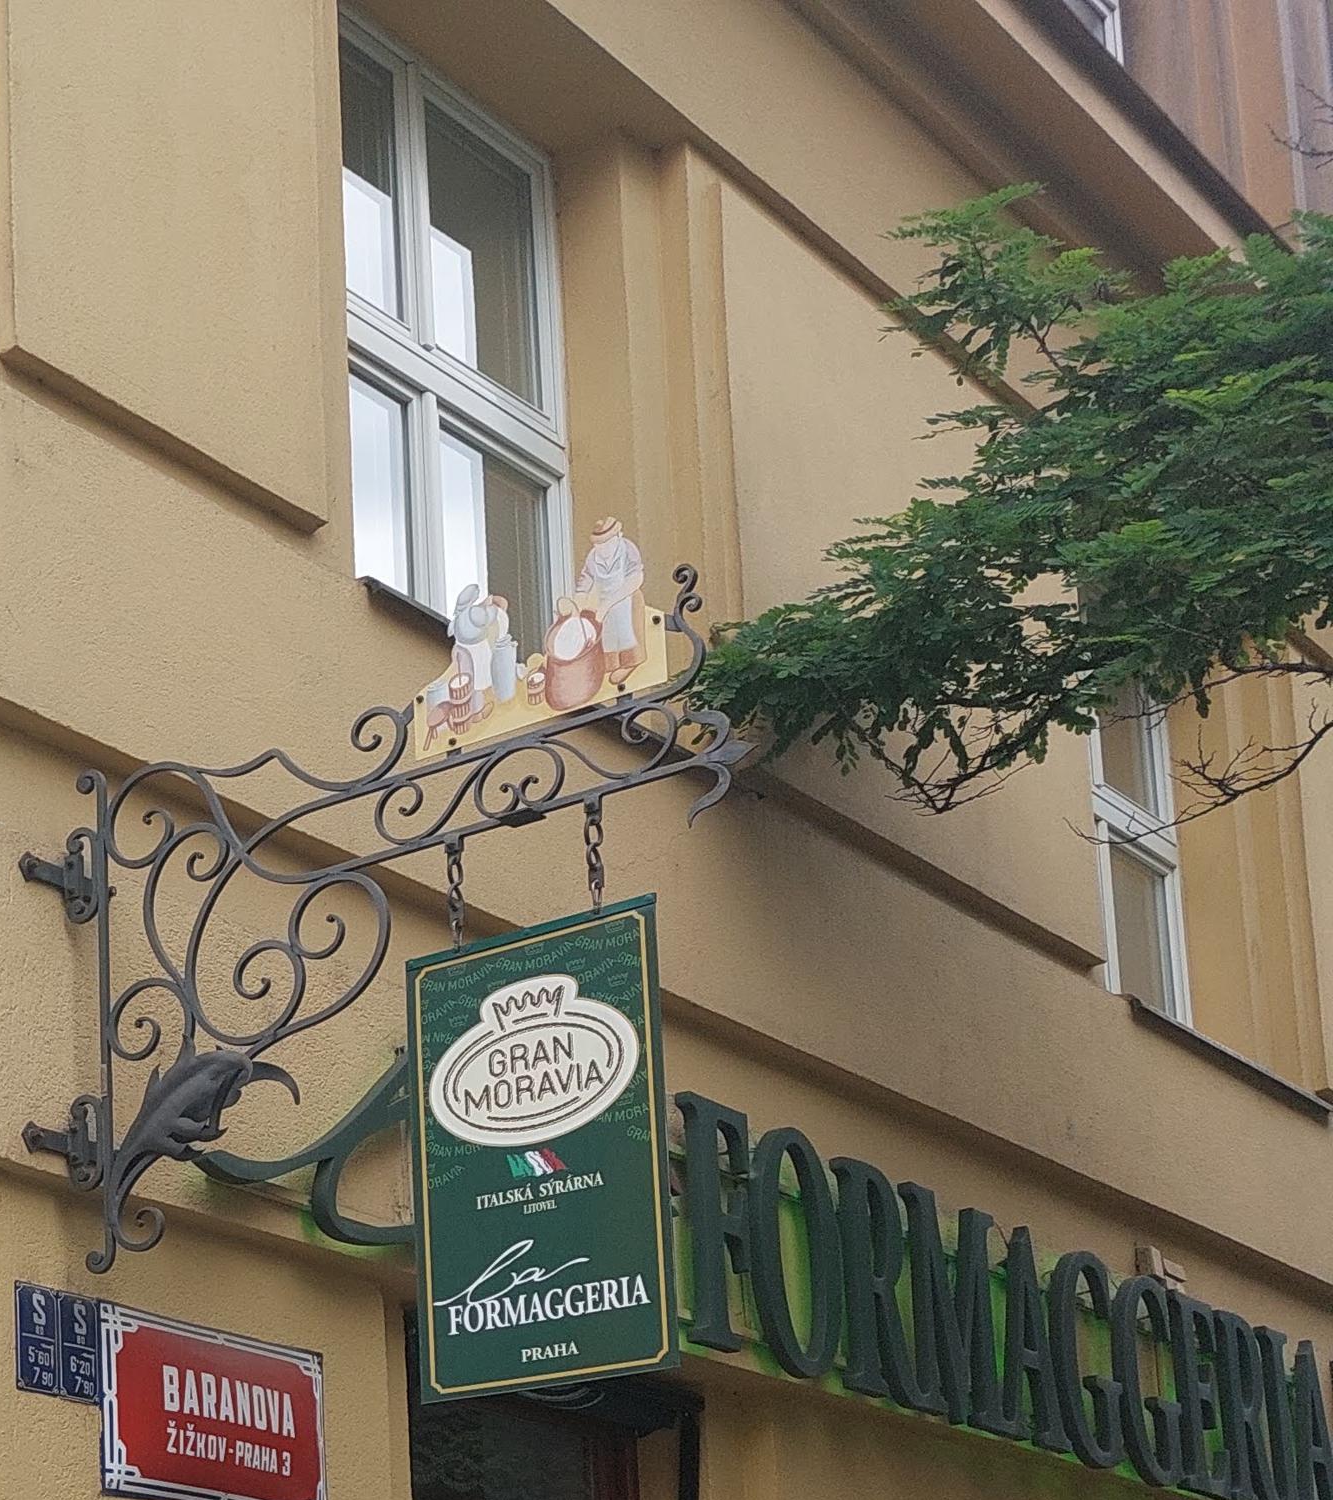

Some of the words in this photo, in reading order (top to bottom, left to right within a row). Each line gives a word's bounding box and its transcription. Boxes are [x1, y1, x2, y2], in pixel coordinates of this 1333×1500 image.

[487, 1031, 576, 1079] GRAN
[464, 1059, 606, 1120] MORAVIA
[476, 1182, 535, 1211] ITALSKÁ
[539, 1170, 605, 1199] SÝRÁRNA
[523, 1200, 558, 1215] LITOVEL
[32, 1289, 46, 1326] Š
[74, 1300, 87, 1336] Š
[447, 1273, 652, 1337] FORMAGGERIA
[521, 1340, 580, 1364] PRAHA
[162, 1363, 296, 1438] BARANOVA
[282, 1450, 291, 1477] 3
